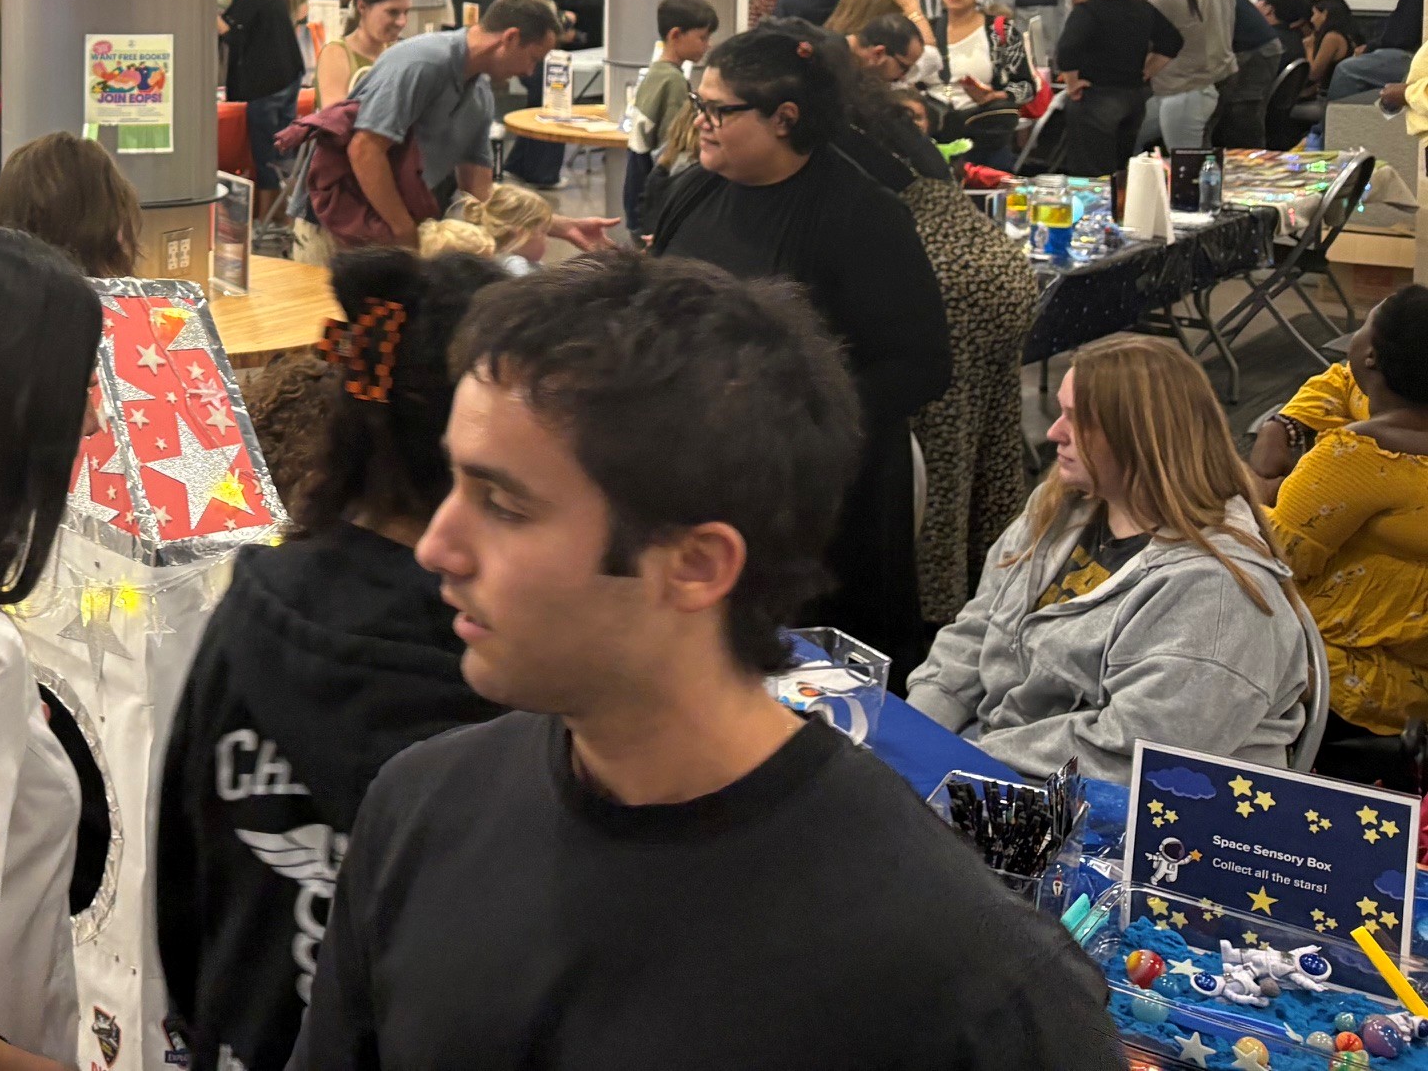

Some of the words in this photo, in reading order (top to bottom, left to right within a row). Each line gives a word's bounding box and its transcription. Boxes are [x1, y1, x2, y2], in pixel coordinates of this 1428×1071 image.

[91, 53, 117, 61] WANT
[118, 53, 138, 61] FREE
[97, 93, 127, 104] JOIN
[129, 93, 162, 104] EOPS!
[1212, 835, 1251, 853] Space
[1253, 844, 1305, 867] Sensory
[1306, 857, 1332, 872] Box
[1212, 857, 1253, 876] Collect
[1254, 868, 1269, 880] all
[1271, 872, 1291, 885] the
[1293, 878, 1327, 894] stars!
